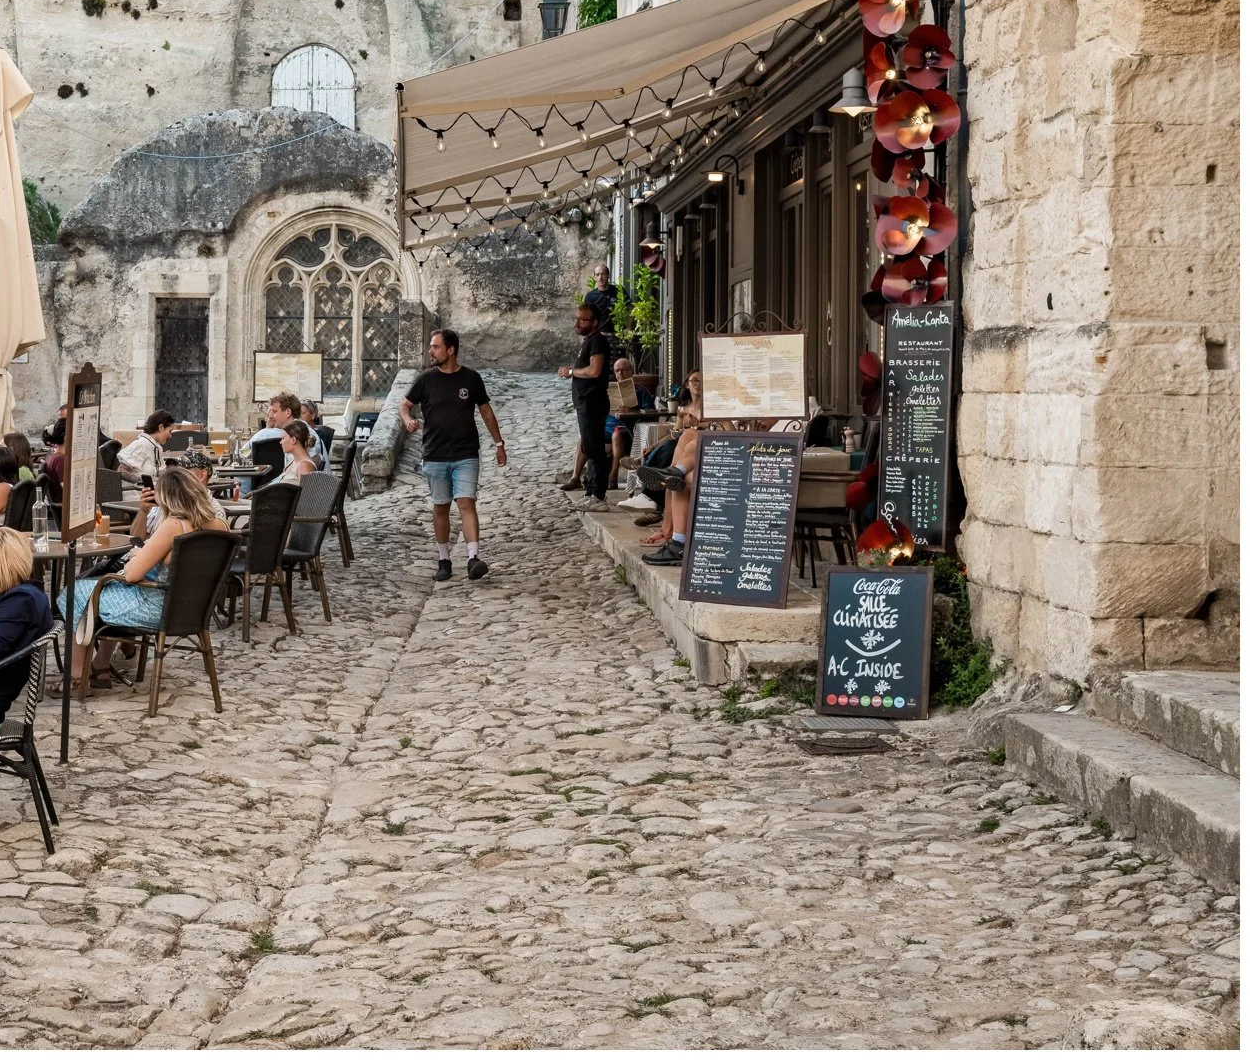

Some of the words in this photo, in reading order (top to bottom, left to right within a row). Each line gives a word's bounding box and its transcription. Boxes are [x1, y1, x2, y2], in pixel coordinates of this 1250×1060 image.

[905, 369, 944, 381] Salades
[905, 395, 942, 406] Omelettes
[776, 446, 792, 456] jour
[853, 577, 904, 595] Coca-Cola
[858, 595, 890, 613] SALLE
[855, 655, 904, 680] INSIDE
